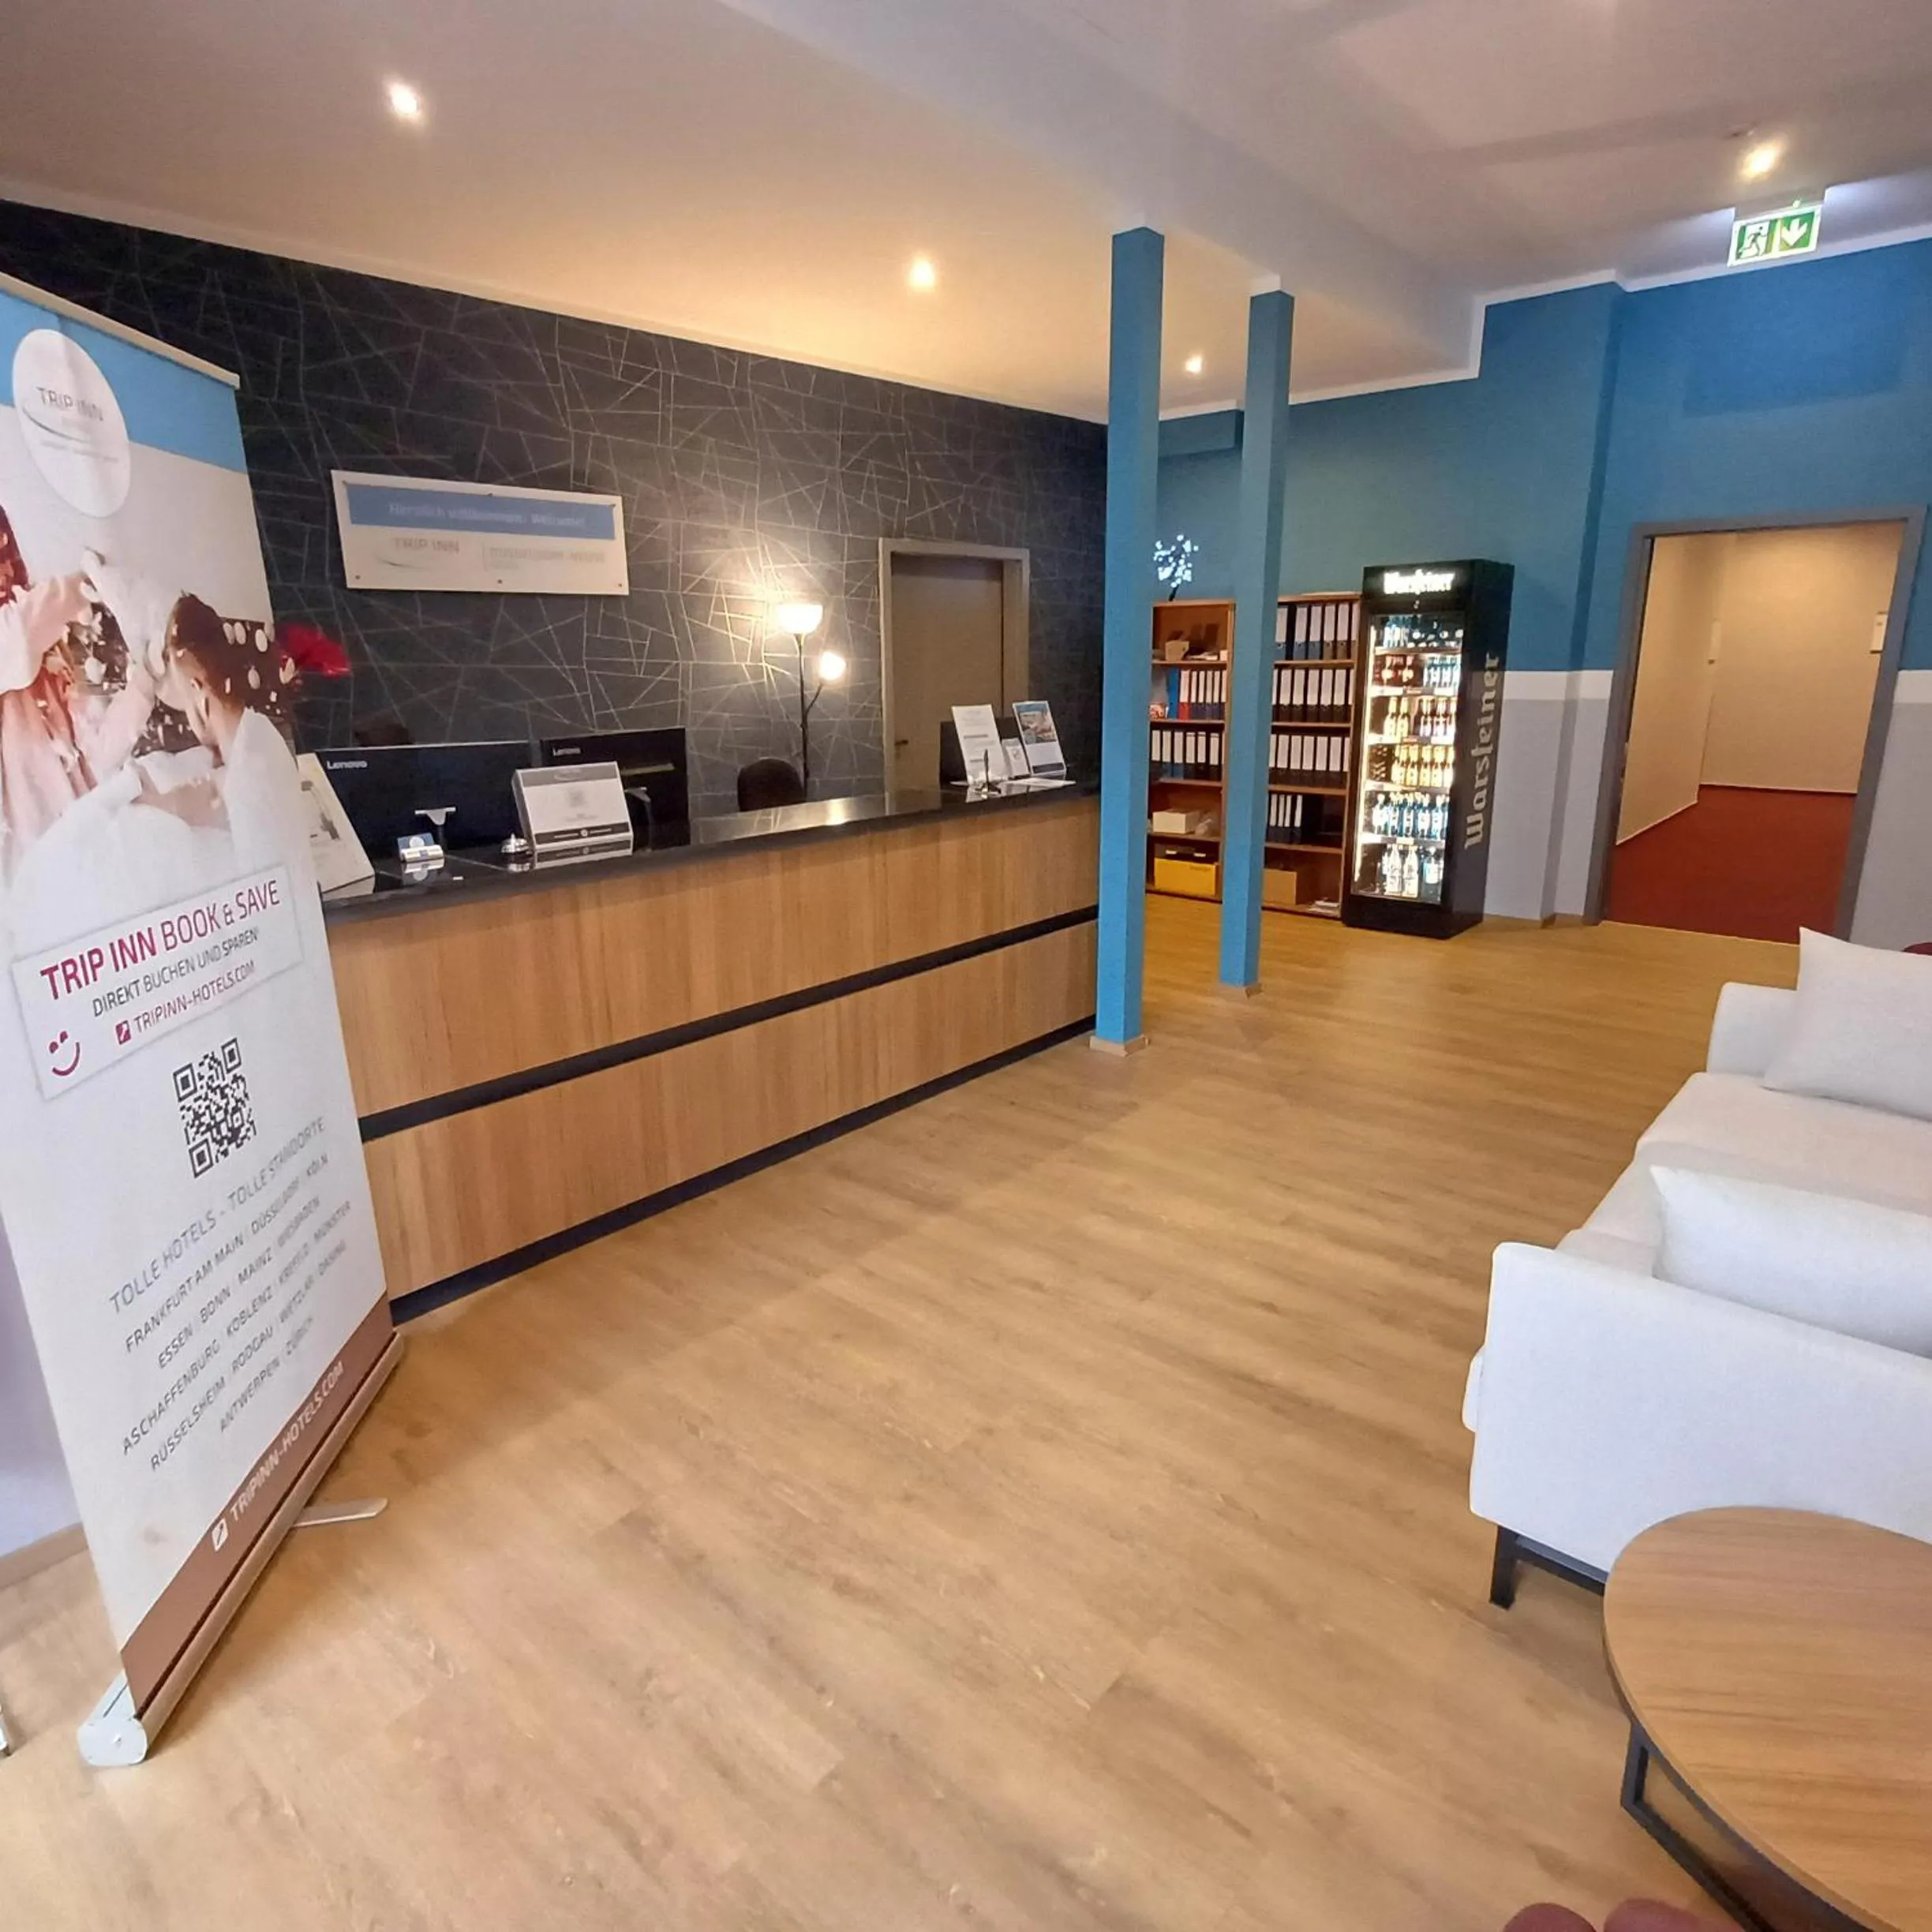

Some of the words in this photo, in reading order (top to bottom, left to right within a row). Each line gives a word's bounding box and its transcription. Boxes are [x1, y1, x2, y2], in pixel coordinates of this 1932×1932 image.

[35, 385, 74, 410] TRIP
[327, 760, 368, 770] Lenovo
[552, 747, 581, 757] Lenovo
[1464, 651, 1499, 849] Warsteiner
[39, 947, 104, 1000] TRIP
[109, 927, 157, 972] INN
[160, 904, 221, 952] BOOK
[223, 904, 234, 926] &
[235, 880, 280, 920] SAVE
[92, 980, 142, 1017] DIREKT
[143, 957, 196, 993] BUCHEN
[197, 945, 222, 969] UND
[133, 960, 255, 1034] TRIPINN-HOTELS.COM
[109, 1259, 161, 1315] TOLLE
[163, 1209, 217, 1269] HOTELS
[227, 1168, 269, 1210] TOLLE
[125, 1276, 193, 1353] FRANKFURT
[195, 1260, 213, 1284] AM
[214, 1232, 244, 1266] MAIN
[158, 1322, 193, 1369] ESSEN
[199, 1285, 231, 1325] BONN
[238, 1246, 273, 1285] MAINZ
[124, 1339, 220, 1455] ASCHAFFENBURG
[227, 1286, 274, 1339] KOBLENZ
[231, 1326, 274, 1374] RODGAU
[221, 1357, 279, 1432] ANTWERPEN
